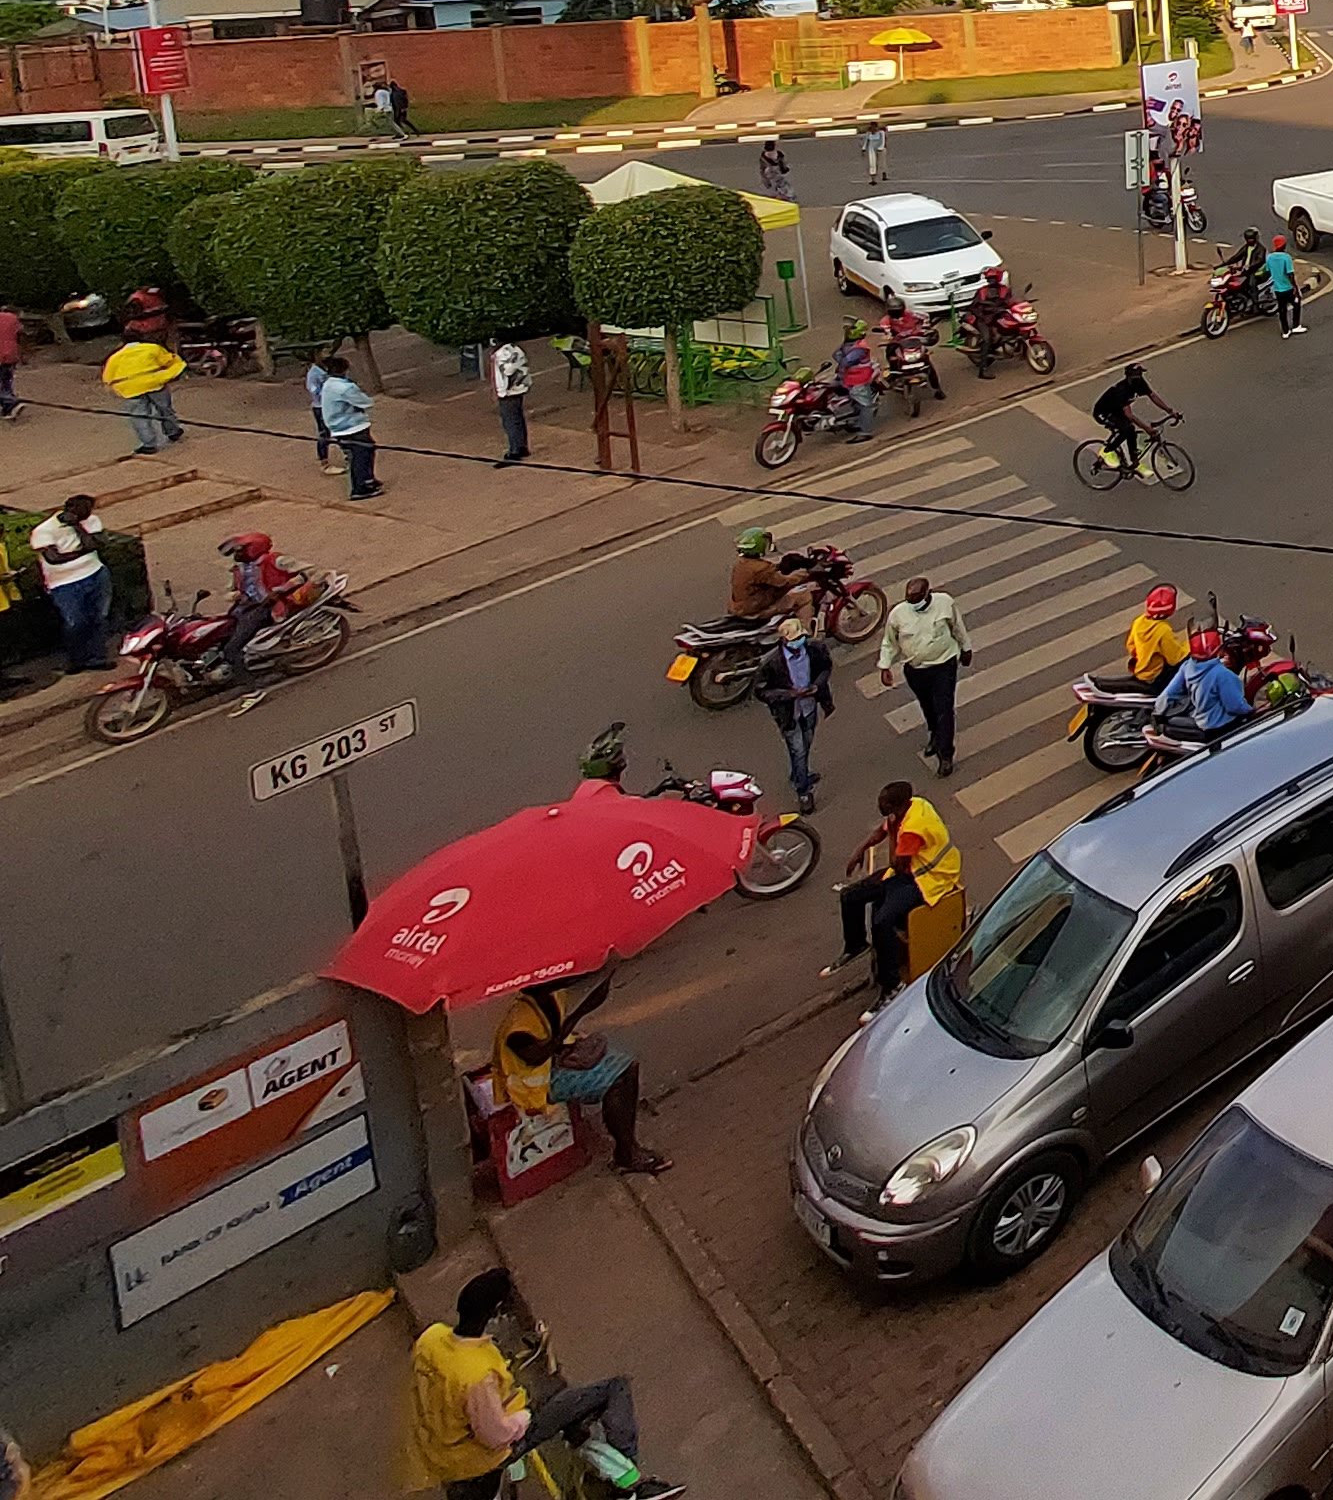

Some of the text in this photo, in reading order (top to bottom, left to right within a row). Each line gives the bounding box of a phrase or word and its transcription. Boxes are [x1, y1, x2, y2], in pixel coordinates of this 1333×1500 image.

[270, 713, 397, 790] KG 203 ST
[630, 859, 686, 900] airtel
[645, 876, 687, 907] money
[383, 947, 427, 970] money
[391, 924, 448, 956] airtel
[261, 1046, 343, 1100] AGENT
[294, 1155, 354, 1198] Agent
